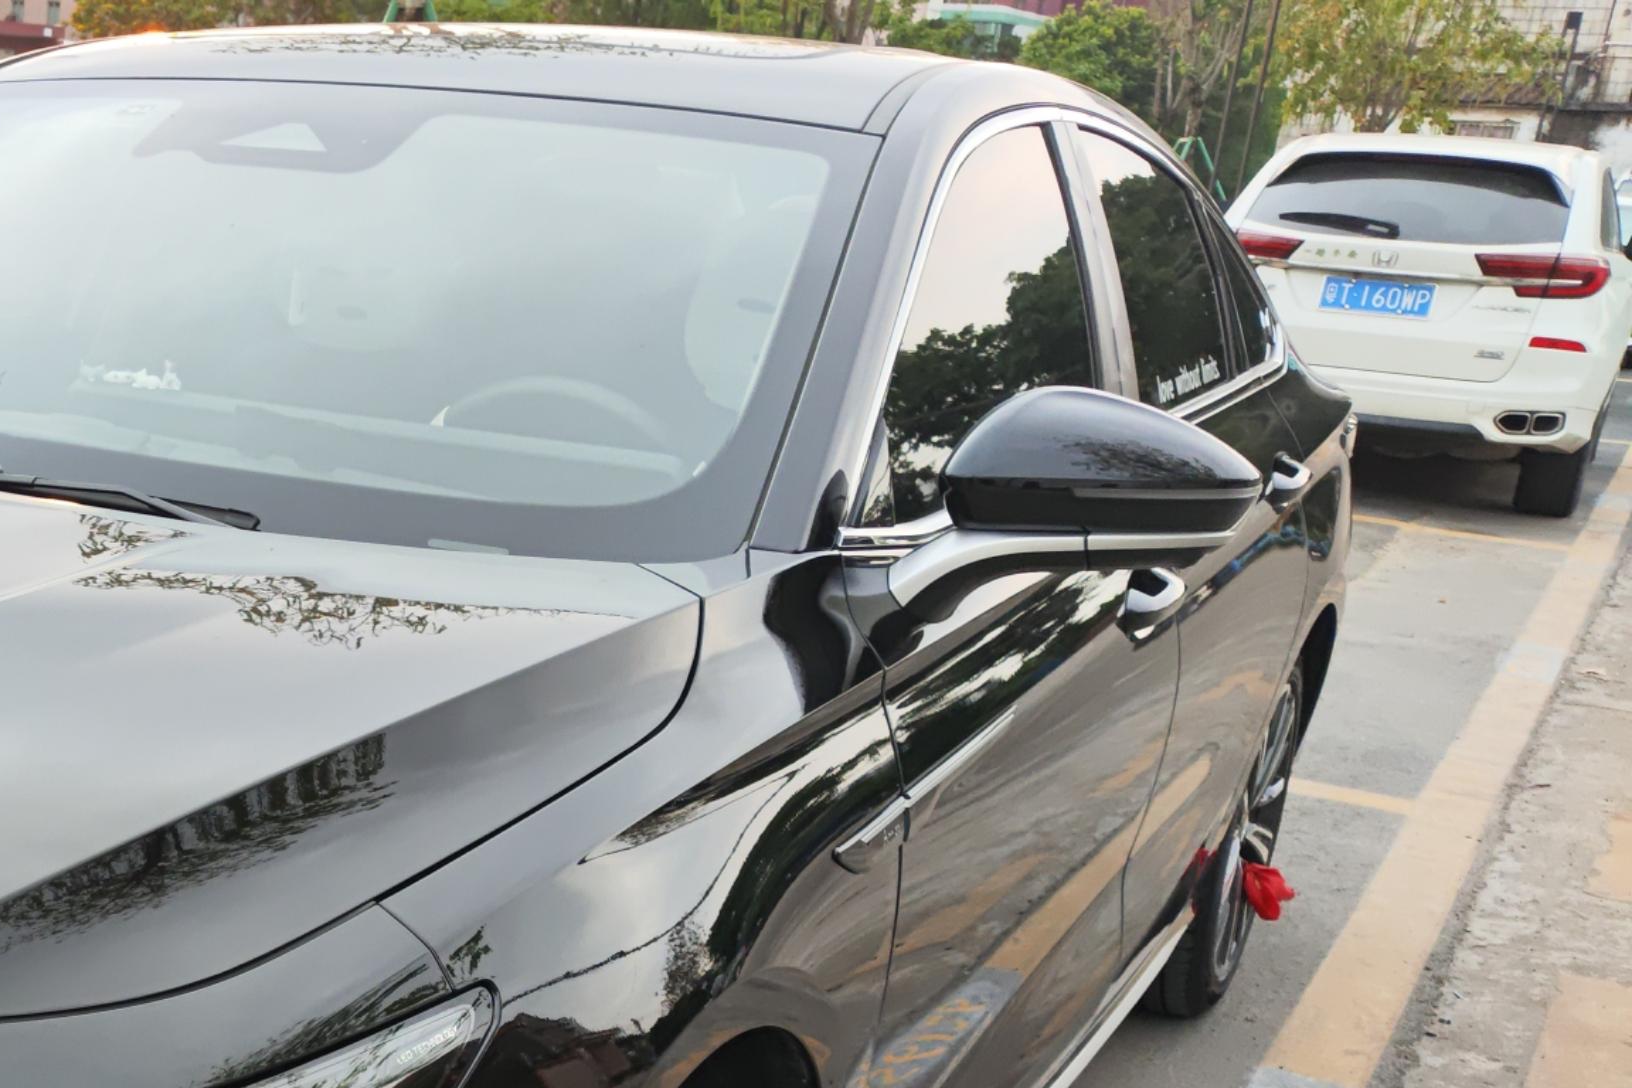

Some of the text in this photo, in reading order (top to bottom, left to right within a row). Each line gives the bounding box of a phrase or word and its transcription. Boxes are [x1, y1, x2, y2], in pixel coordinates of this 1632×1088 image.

[1156, 354, 1221, 404] love without limits
[396, 1050, 413, 1065] LED
